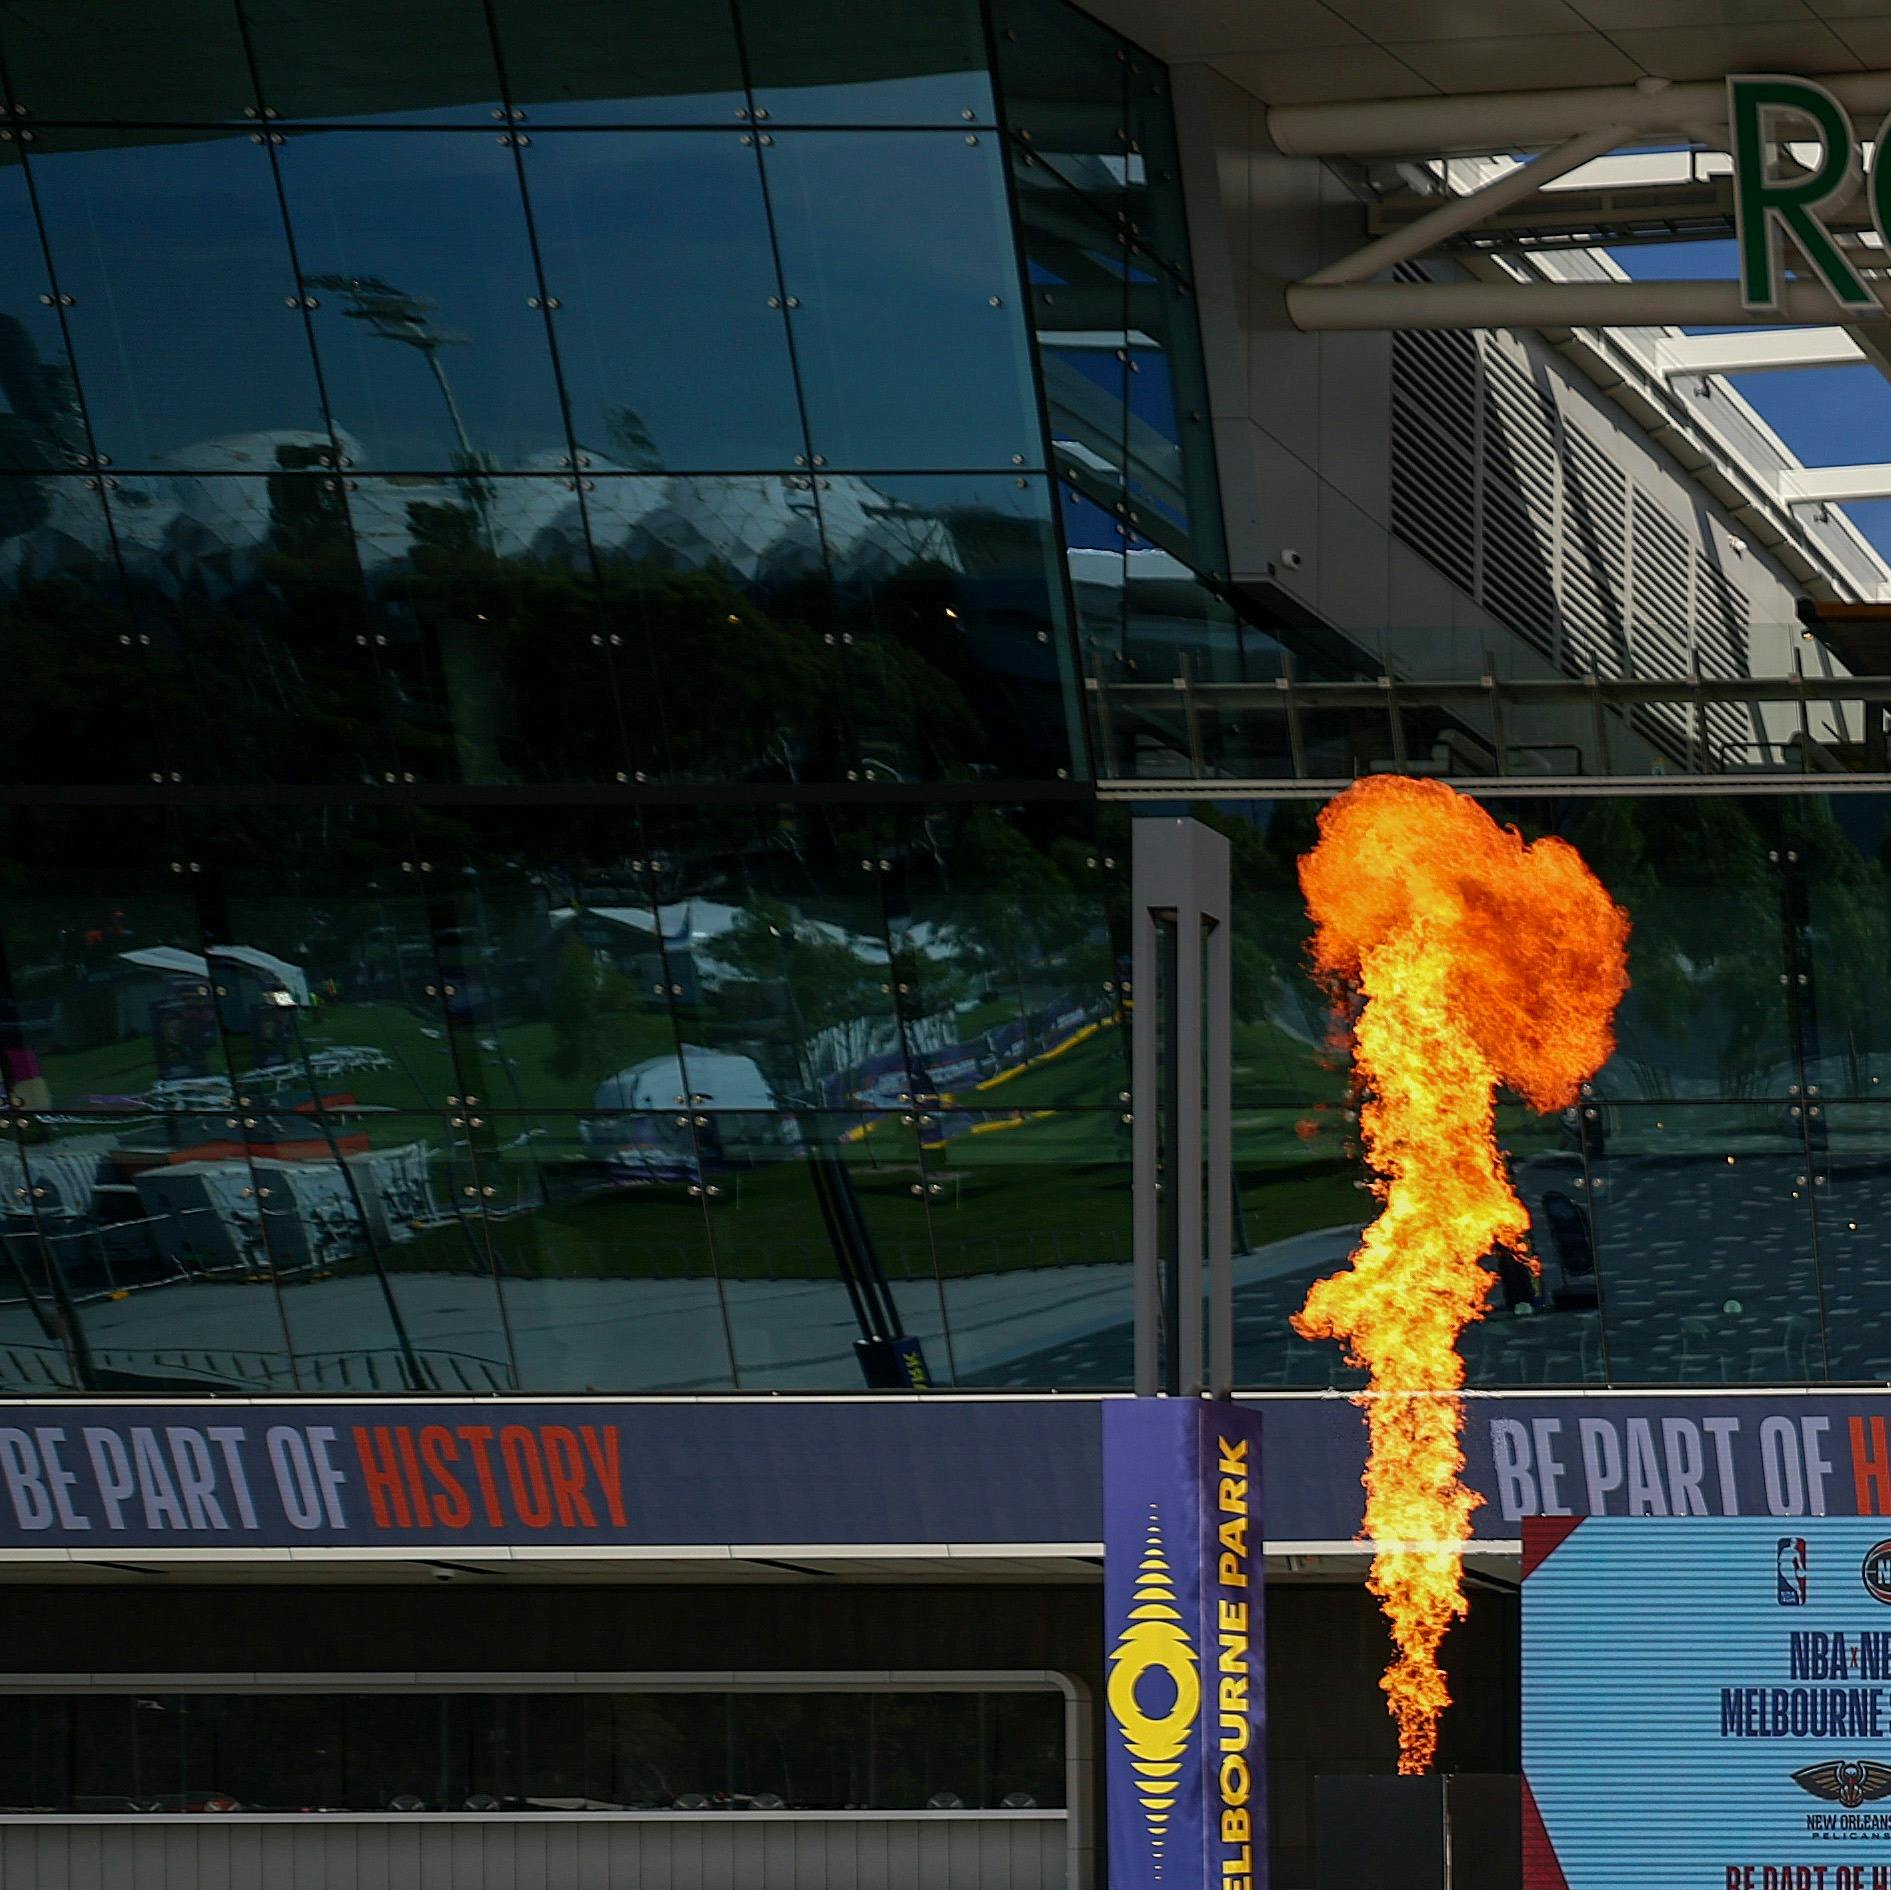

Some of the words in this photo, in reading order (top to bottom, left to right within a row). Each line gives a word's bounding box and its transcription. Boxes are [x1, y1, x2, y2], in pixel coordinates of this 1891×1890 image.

[0, 1427, 91, 1530] BE
[82, 1427, 261, 1530] PART
[266, 1425, 350, 1530] OF
[352, 1425, 628, 1528] HISTORY
[1489, 1418, 1572, 1521] BE
[1578, 1416, 1741, 1516] PART
[1759, 1415, 1833, 1516] OF
[1217, 1434, 1250, 1588] PARK
[1790, 1631, 1848, 1681] NBA
[1720, 1687, 1883, 1737] MELBOURNE
[1806, 1814, 1837, 1831] NEW
[1811, 1832, 1891, 1840] PELICANS
